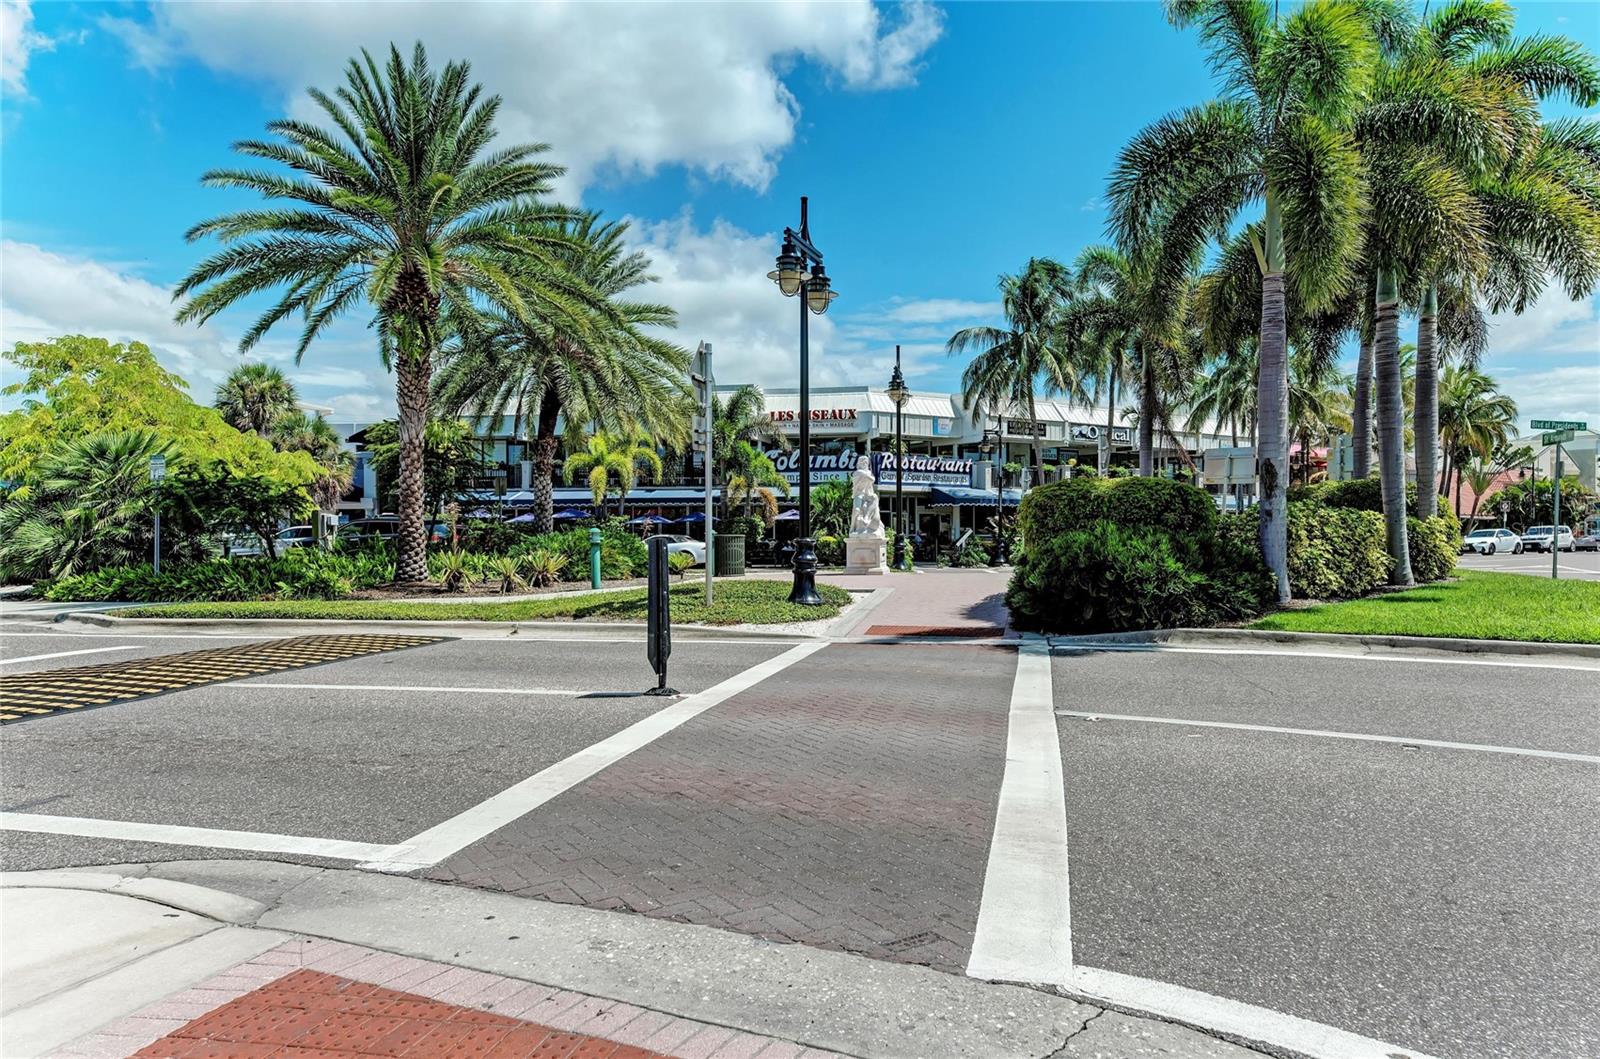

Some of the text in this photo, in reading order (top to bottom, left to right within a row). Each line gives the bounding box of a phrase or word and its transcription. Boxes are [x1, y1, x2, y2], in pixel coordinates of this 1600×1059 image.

[770, 411, 794, 421] LES
[1088, 425, 1130, 441] Oical
[812, 472, 840, 481] Since
